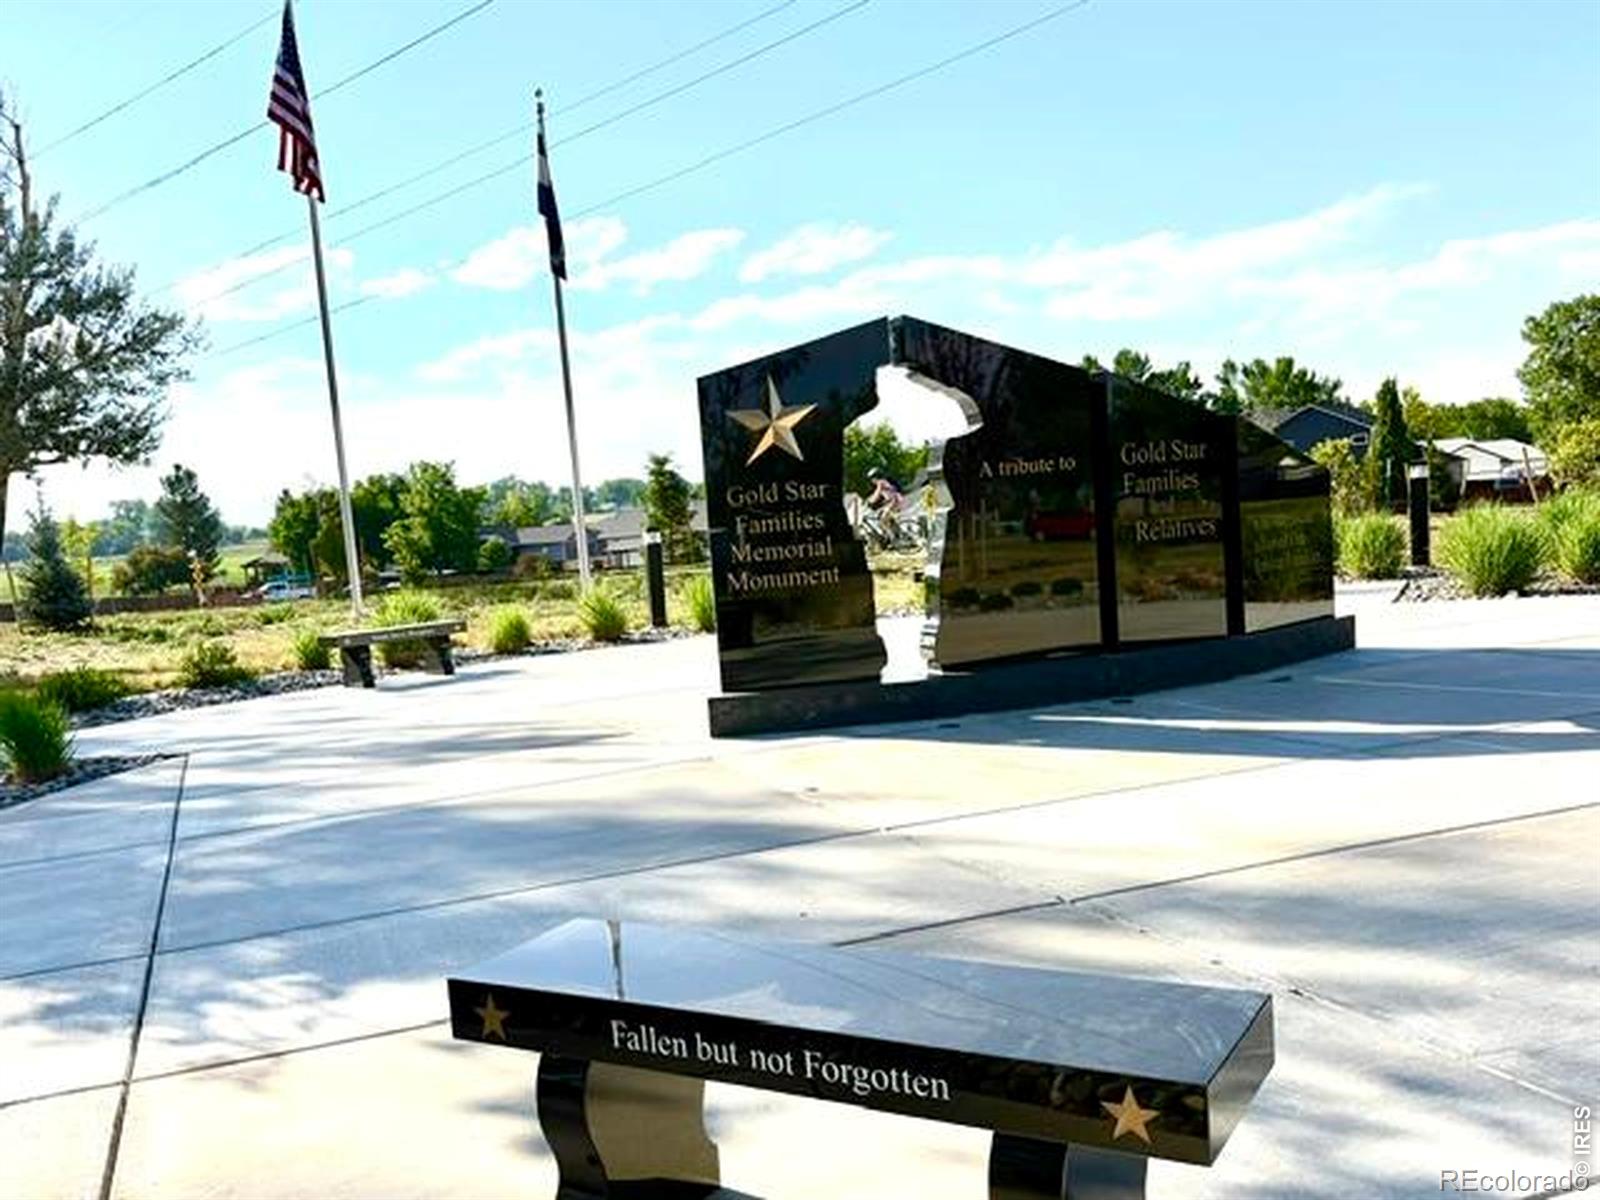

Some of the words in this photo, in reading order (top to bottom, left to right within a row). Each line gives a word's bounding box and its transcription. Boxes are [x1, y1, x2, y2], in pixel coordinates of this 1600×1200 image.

[1120, 440, 1166, 466] Gold
[1170, 439, 1207, 461] Star
[979, 461, 993, 478] A
[999, 458, 1055, 477] tribute
[1059, 456, 1077, 471] to
[726, 481, 778, 507] Gold
[785, 480, 829, 501] Star
[1123, 468, 1200, 494] Families
[735, 511, 824, 535] Families
[1136, 517, 1217, 541] Relatives
[731, 536, 833, 563] Memorial
[727, 566, 840, 592] Monument
[610, 1019, 688, 1059] Fallen
[695, 1031, 738, 1066] but
[750, 1049, 794, 1077] not
[803, 1049, 950, 1101] Forgotten
